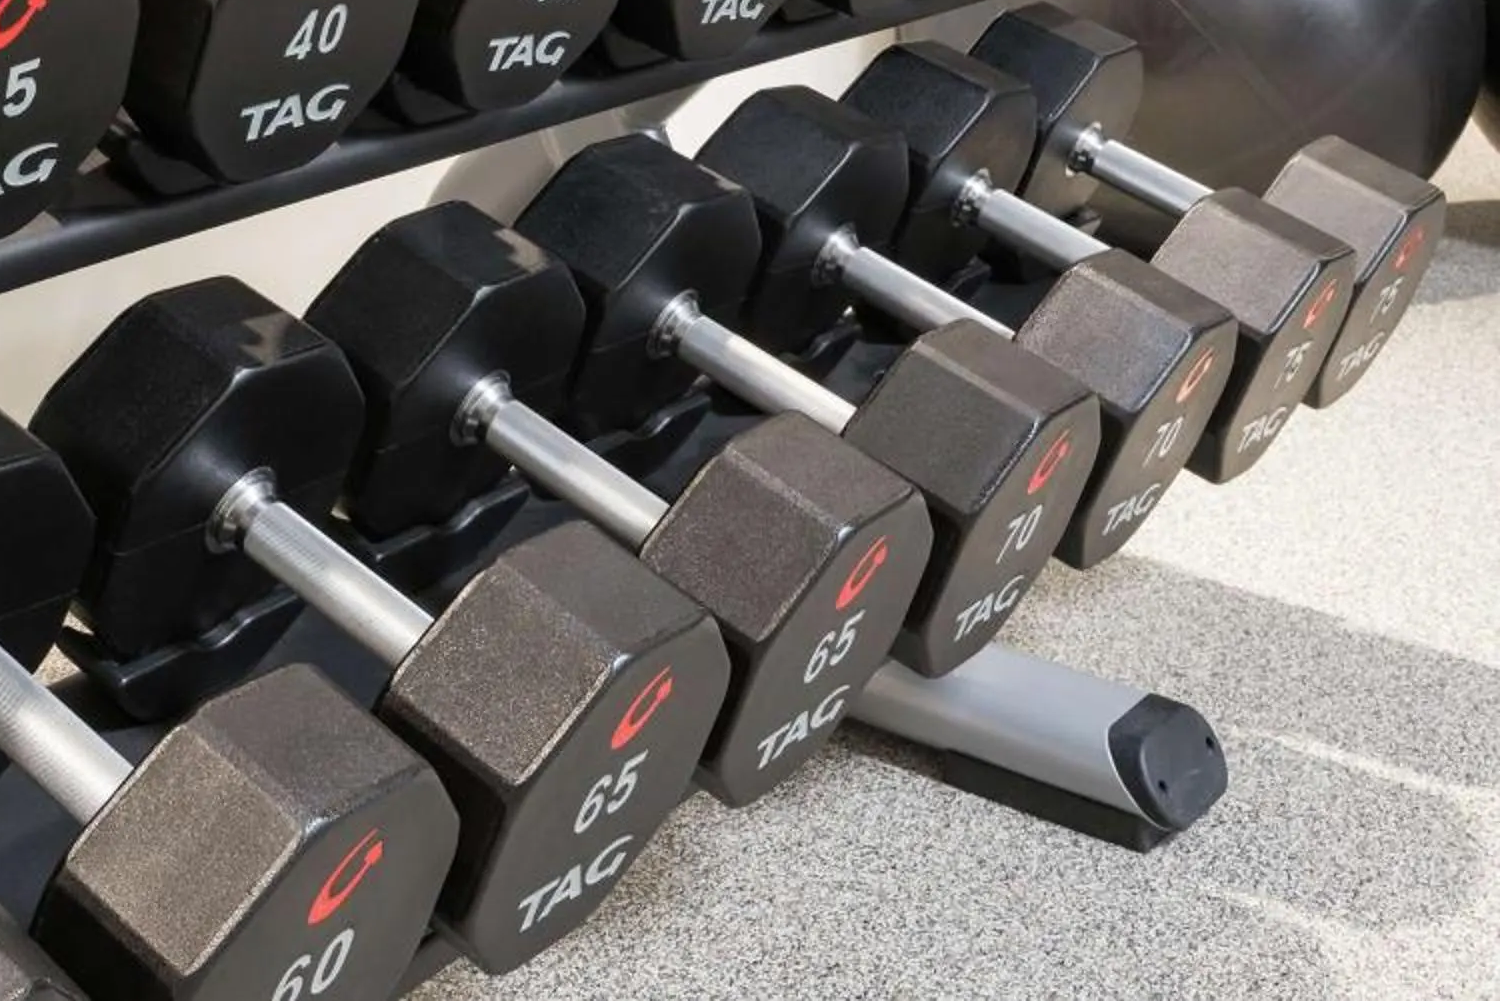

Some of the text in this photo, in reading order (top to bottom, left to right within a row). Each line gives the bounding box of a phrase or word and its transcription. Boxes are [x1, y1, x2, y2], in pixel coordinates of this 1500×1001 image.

[284, 3, 348, 60] 40
[488, 30, 571, 72] TAG
[240, 83, 350, 142] TAG
[1274, 341, 1312, 389] 75
[1337, 332, 1386, 377] TAG
[1143, 415, 1185, 467] 70
[1237, 406, 1288, 454] TAG
[995, 504, 1043, 565] 70
[1102, 483, 1162, 536] TAG
[954, 574, 1026, 643] TAG
[803, 609, 866, 684] 65
[756, 684, 851, 770] TAG
[573, 749, 649, 834] 65
[518, 833, 636, 933] TAG
[271, 928, 355, 1001] 60
